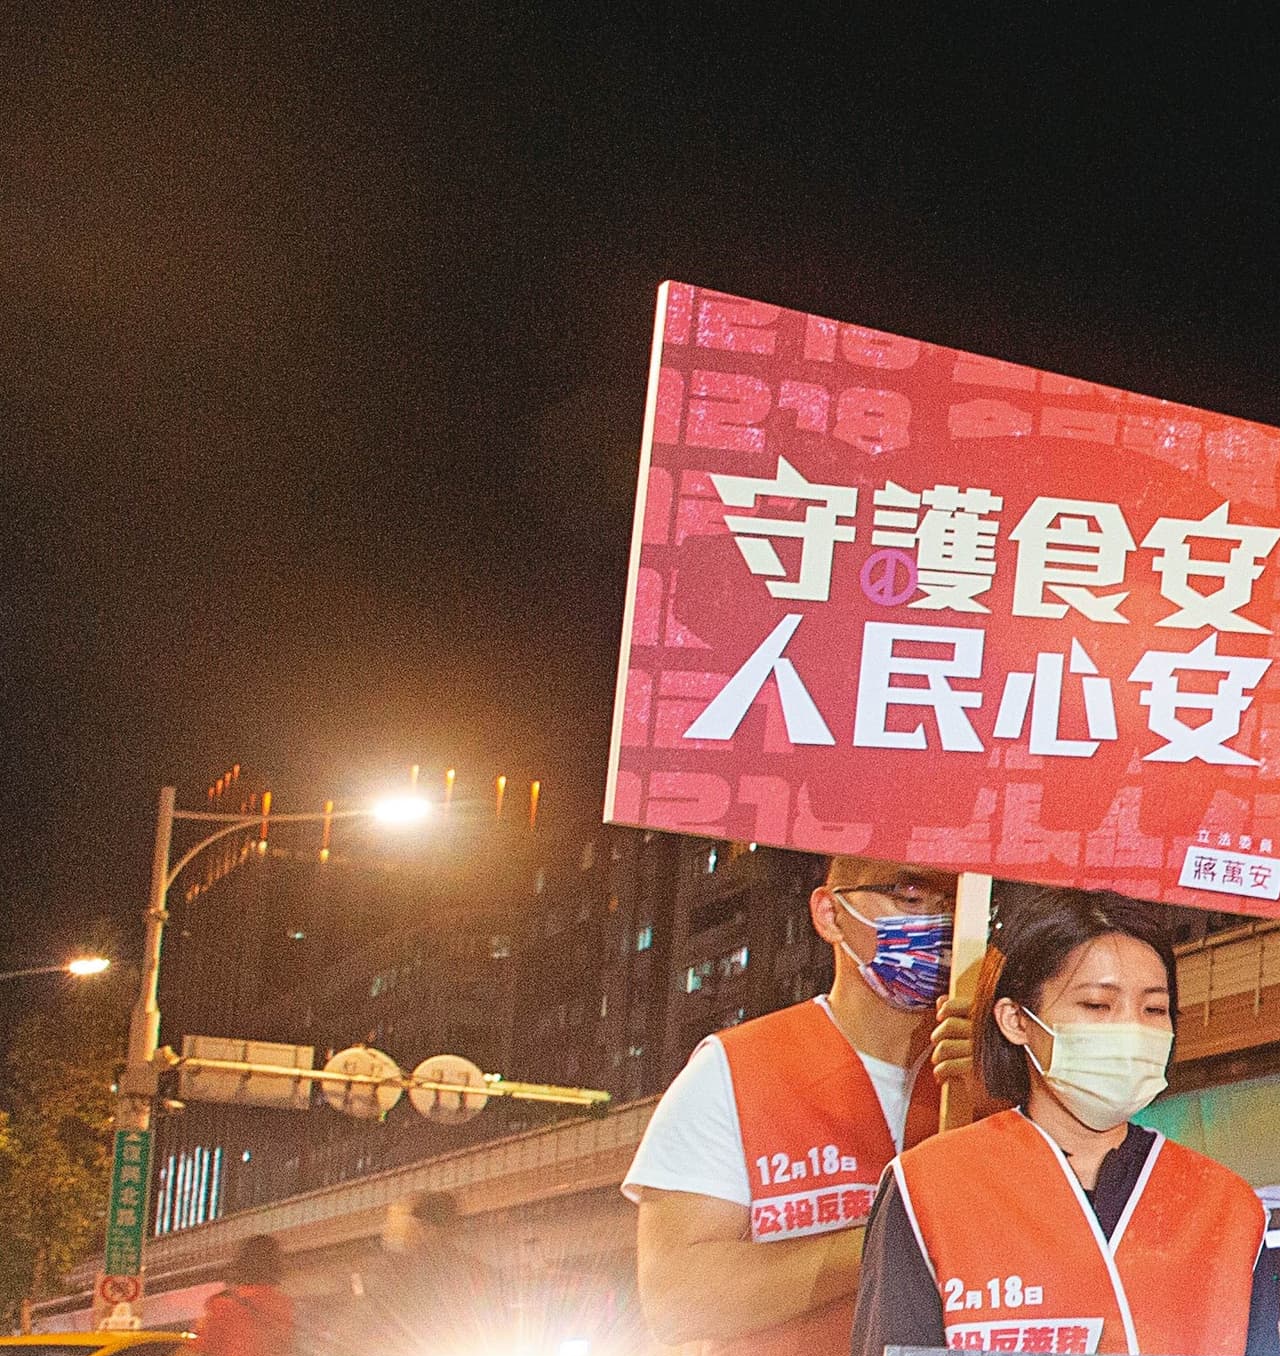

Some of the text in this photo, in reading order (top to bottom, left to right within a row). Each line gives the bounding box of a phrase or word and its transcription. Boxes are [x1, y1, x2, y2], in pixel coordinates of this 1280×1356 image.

[683, 614, 1273, 767] 人民心安
[1194, 856, 1272, 890] 蔣萬安
[756, 1144, 857, 1186] 12月18日
[754, 1189, 877, 1236] 公投反萊
[939, 1275, 1043, 1312] 2月18日
